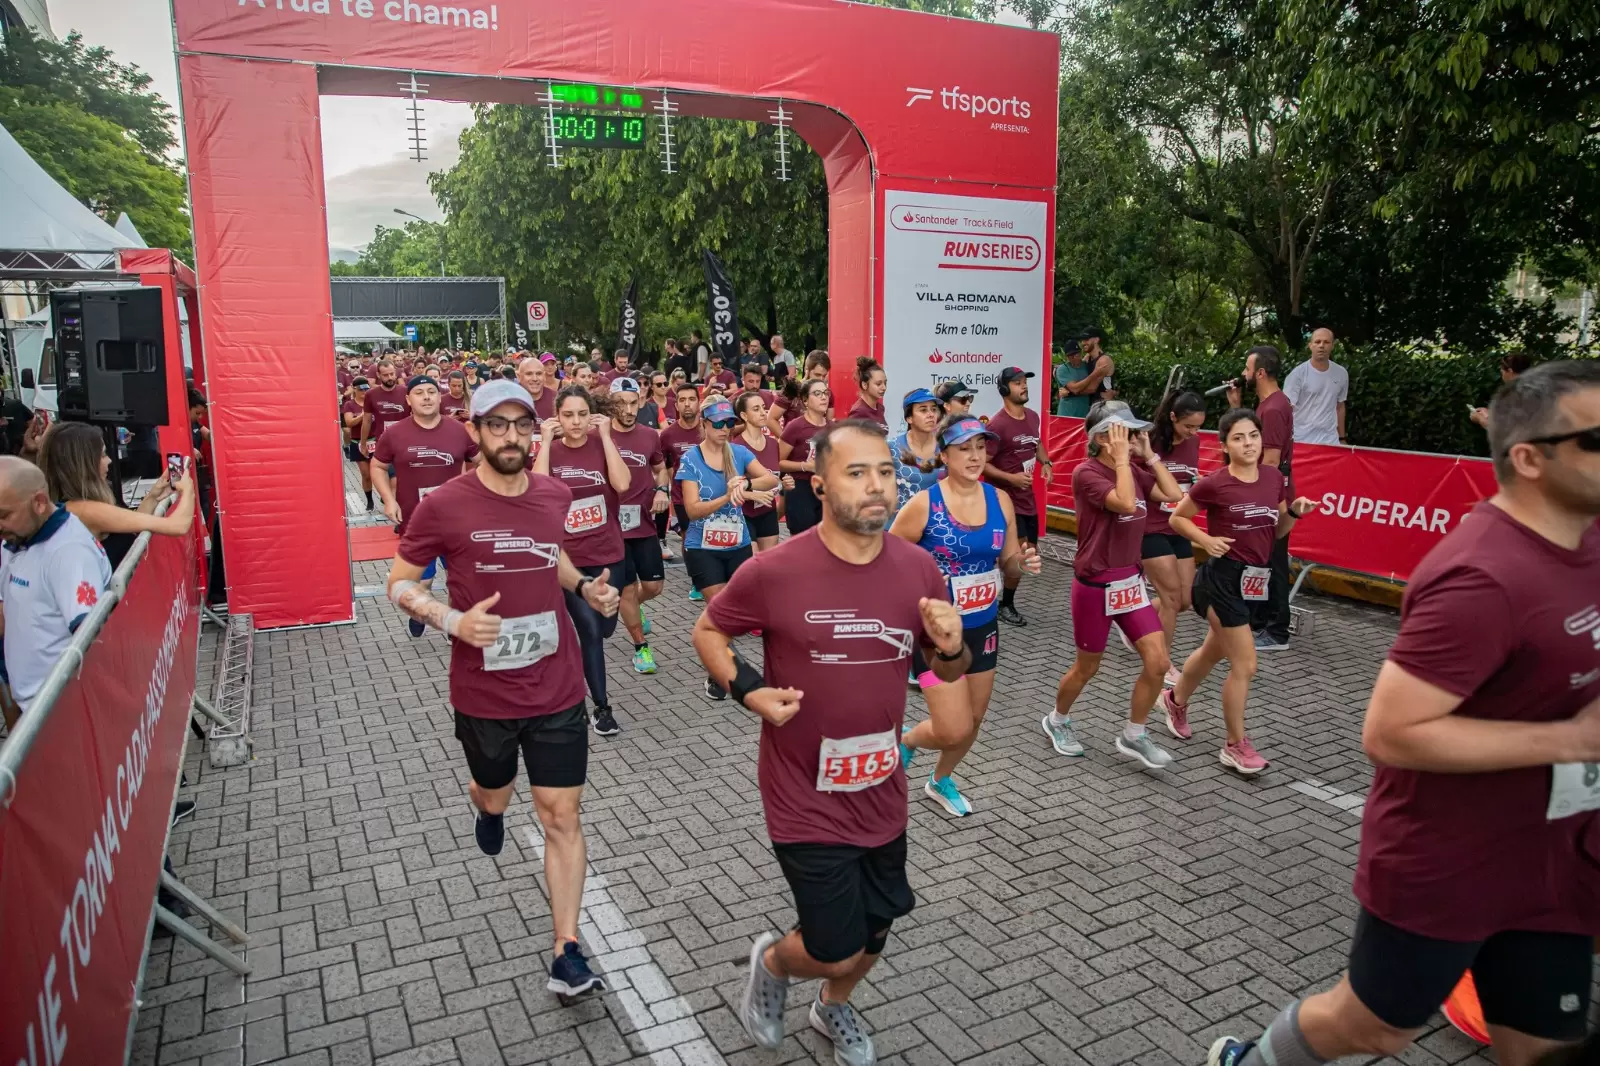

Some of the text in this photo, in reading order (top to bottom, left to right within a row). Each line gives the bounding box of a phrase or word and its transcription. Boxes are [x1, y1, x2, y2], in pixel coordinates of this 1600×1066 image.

[343, 0, 374, 18] te
[383, 0, 499, 31] chama!
[940, 86, 1031, 118] tfsports
[915, 214, 958, 226] Santander
[916, 292, 1016, 304] VILLA ROMANA
[944, 304, 989, 312] SHOPPING
[935, 323, 998, 335] 5km e 10km
[945, 351, 1003, 363] Santander
[567, 506, 601, 525] 5333
[1319, 492, 1450, 534] SUPERAR
[706, 531, 737, 543] 5437
[960, 583, 995, 605] 5427
[1110, 585, 1141, 606] 5192
[496, 631, 541, 657] 272
[828, 749, 895, 777] 5165
[60, 796, 121, 1003] TORNA
[117, 712, 149, 831] CADA
